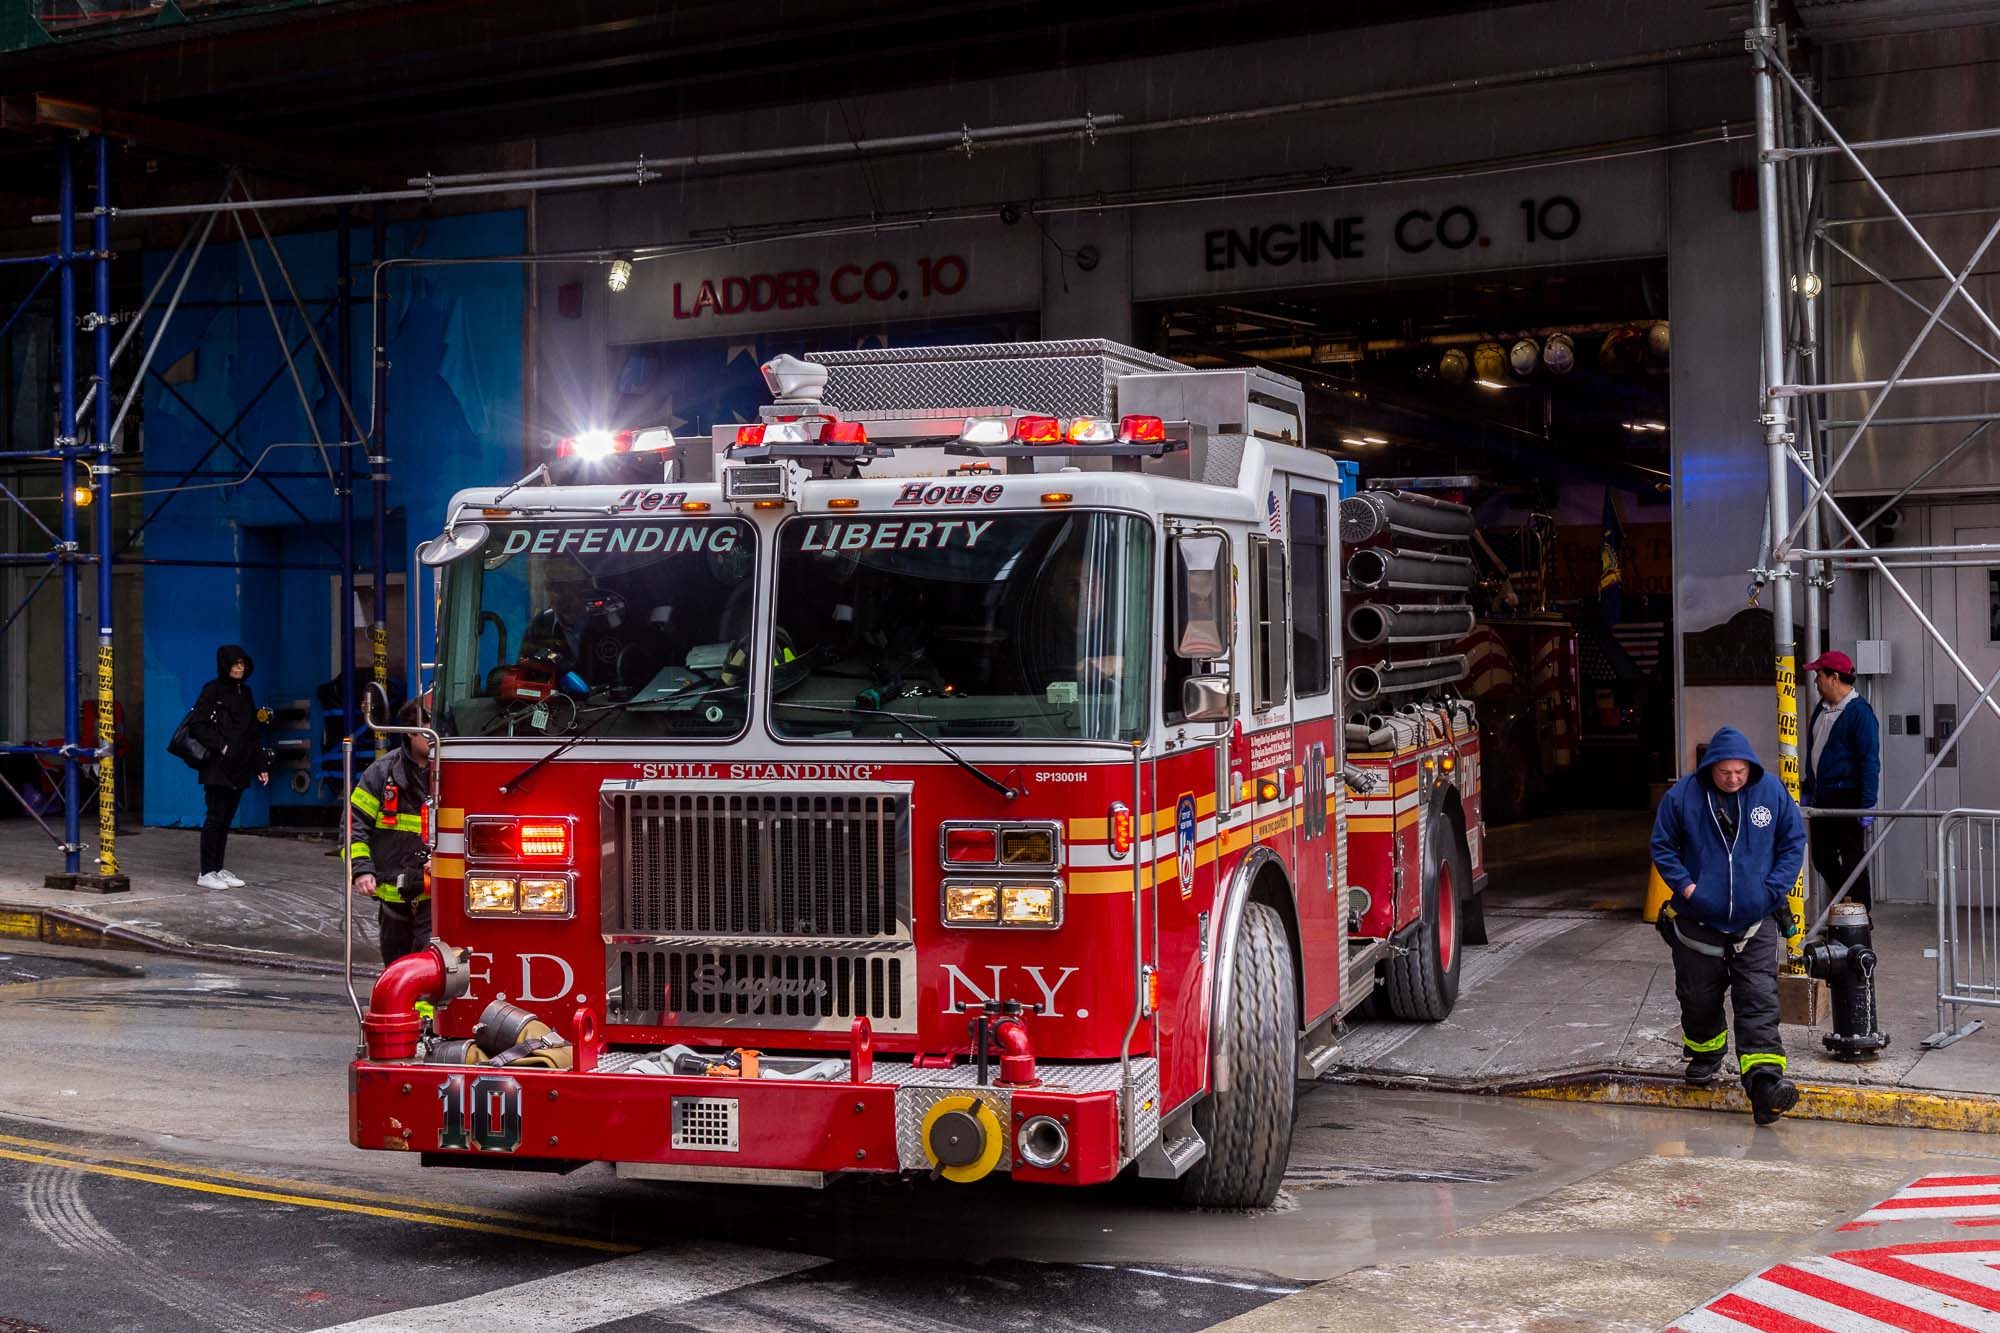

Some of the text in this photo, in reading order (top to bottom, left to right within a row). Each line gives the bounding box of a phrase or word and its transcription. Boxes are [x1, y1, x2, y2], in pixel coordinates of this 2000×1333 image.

[1204, 196, 1581, 272] ENGINE CO. 10
[673, 255, 967, 320] LADDER CO. 10
[620, 481, 1004, 512] Ten House
[502, 519, 994, 555] DEFENDING LIBERTY
[1035, 772, 1088, 784] SP13001H
[437, 1074, 523, 1153] 10
